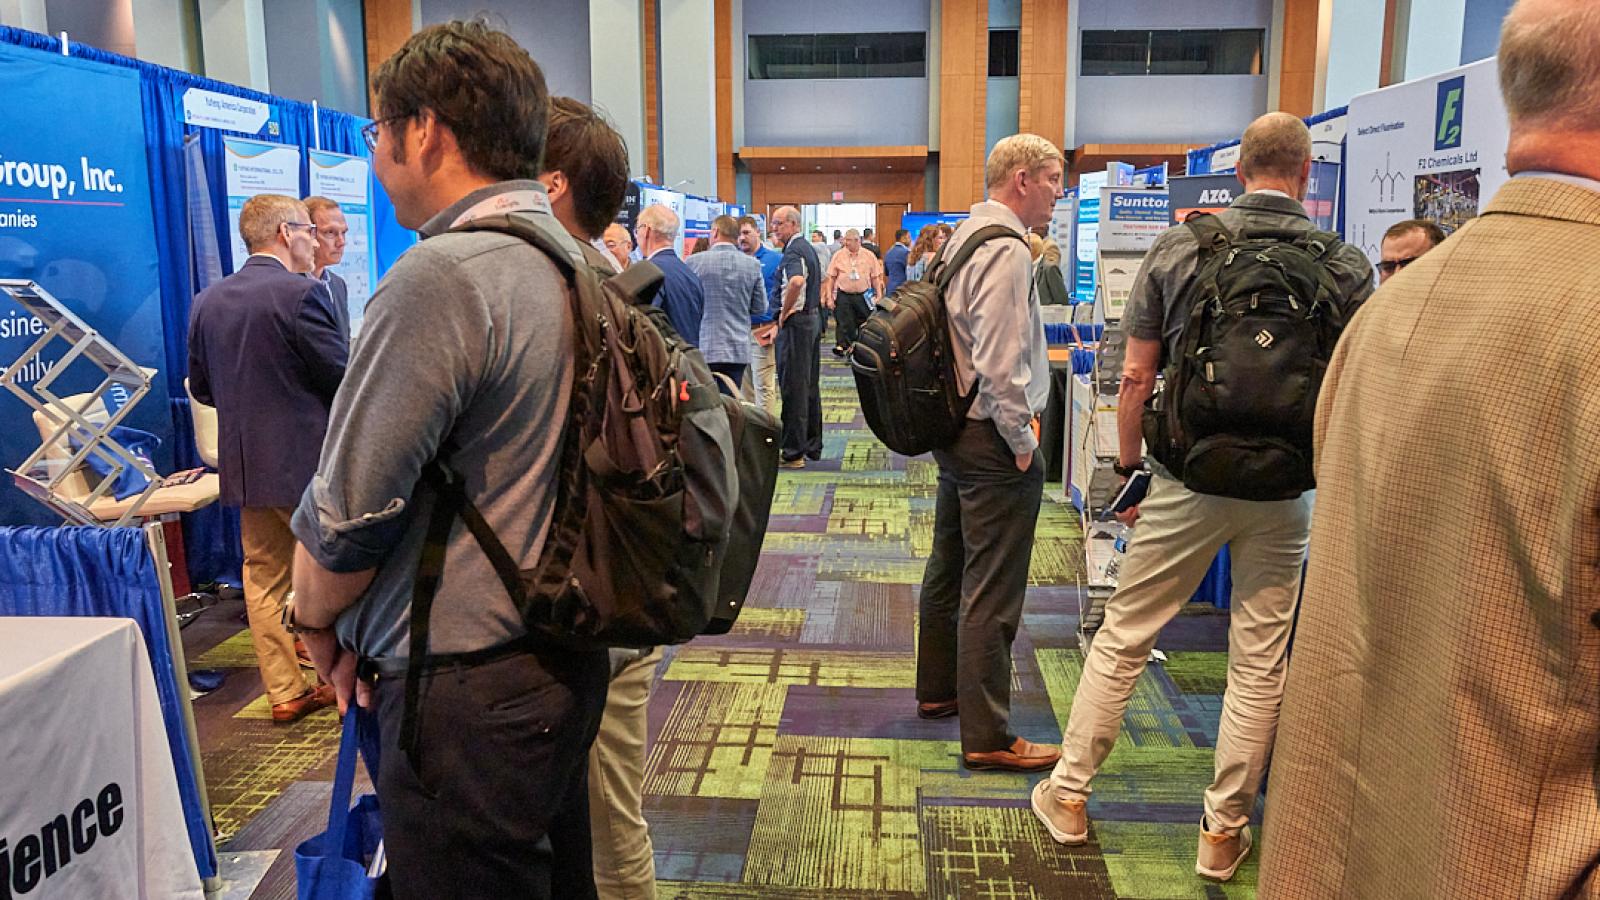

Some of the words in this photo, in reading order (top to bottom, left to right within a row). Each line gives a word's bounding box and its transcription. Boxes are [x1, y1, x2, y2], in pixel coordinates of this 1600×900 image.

[1427, 153, 1463, 168] Chemicals
[1465, 150, 1478, 163] Ltd
[0, 154, 77, 200] roup,
[80, 155, 124, 193] Inc.
[0, 208, 38, 228] anies
